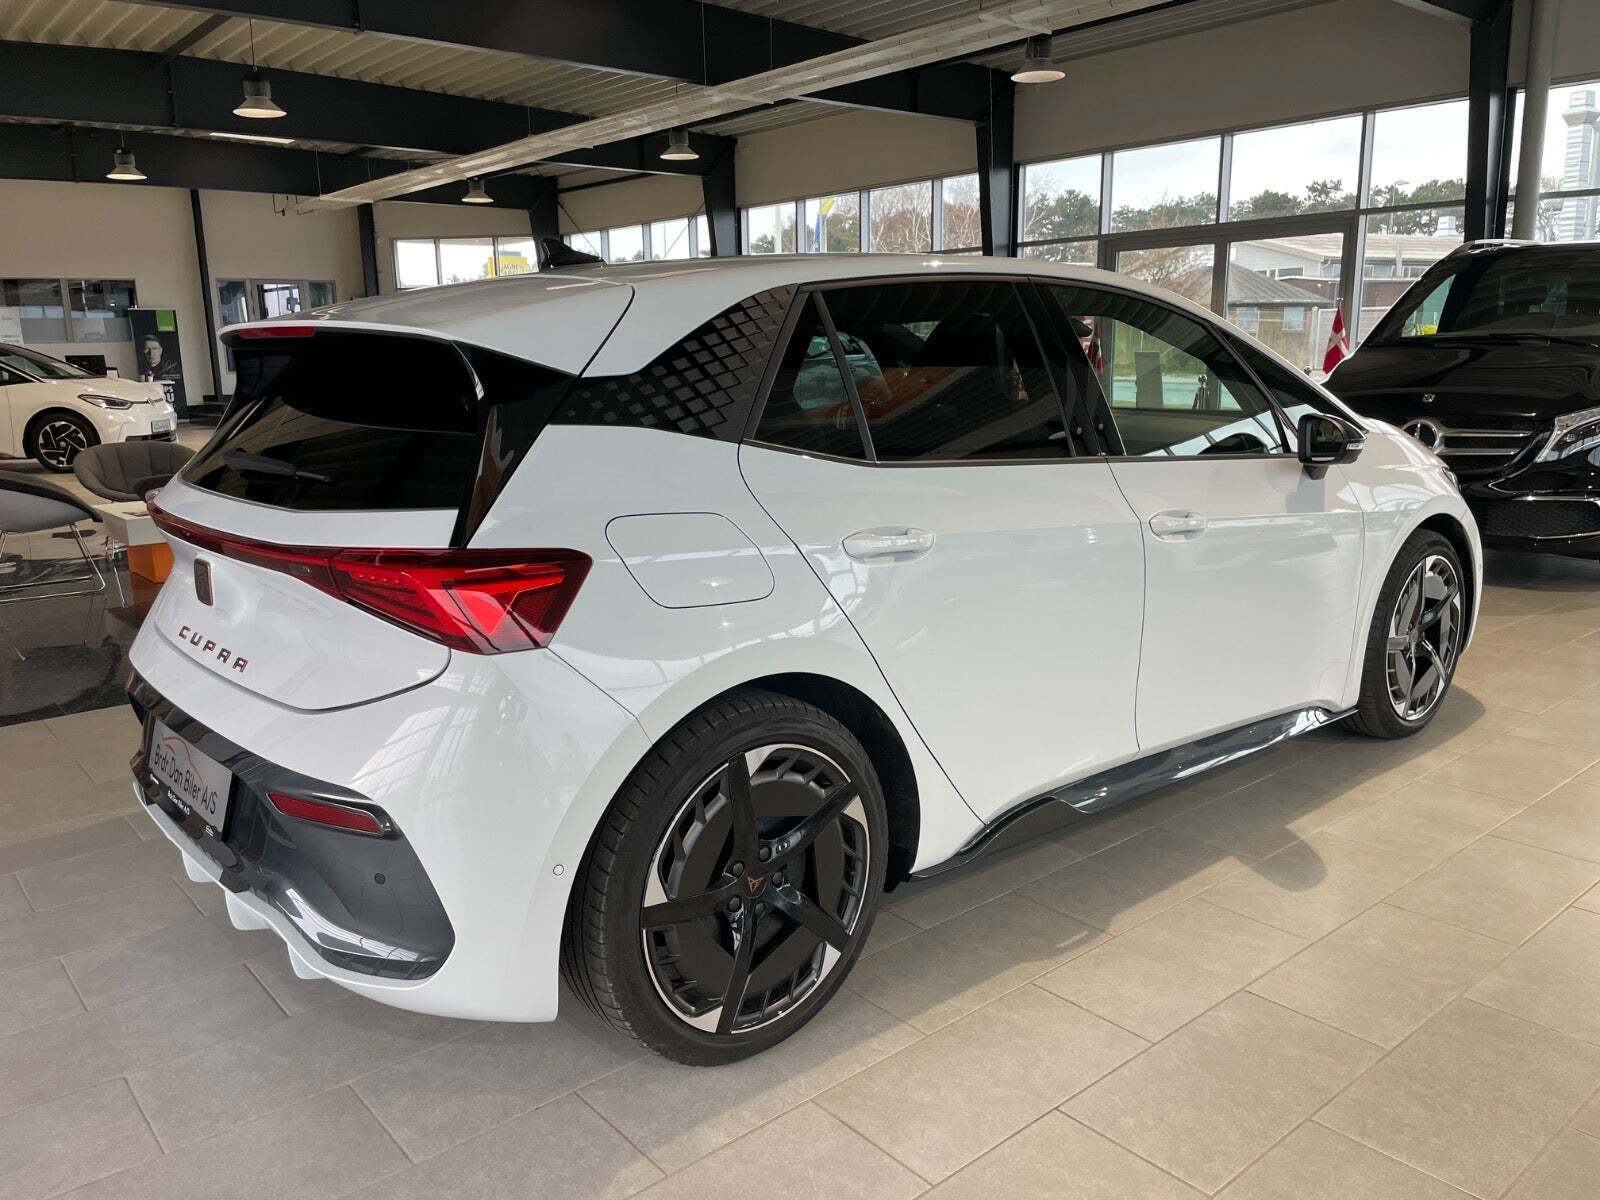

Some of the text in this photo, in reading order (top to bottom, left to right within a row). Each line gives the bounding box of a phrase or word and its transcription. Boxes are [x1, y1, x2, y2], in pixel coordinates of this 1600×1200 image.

[178, 625, 249, 673] CUPRA
[183, 769, 202, 801] Biler
[201, 785, 218, 815] A/S
